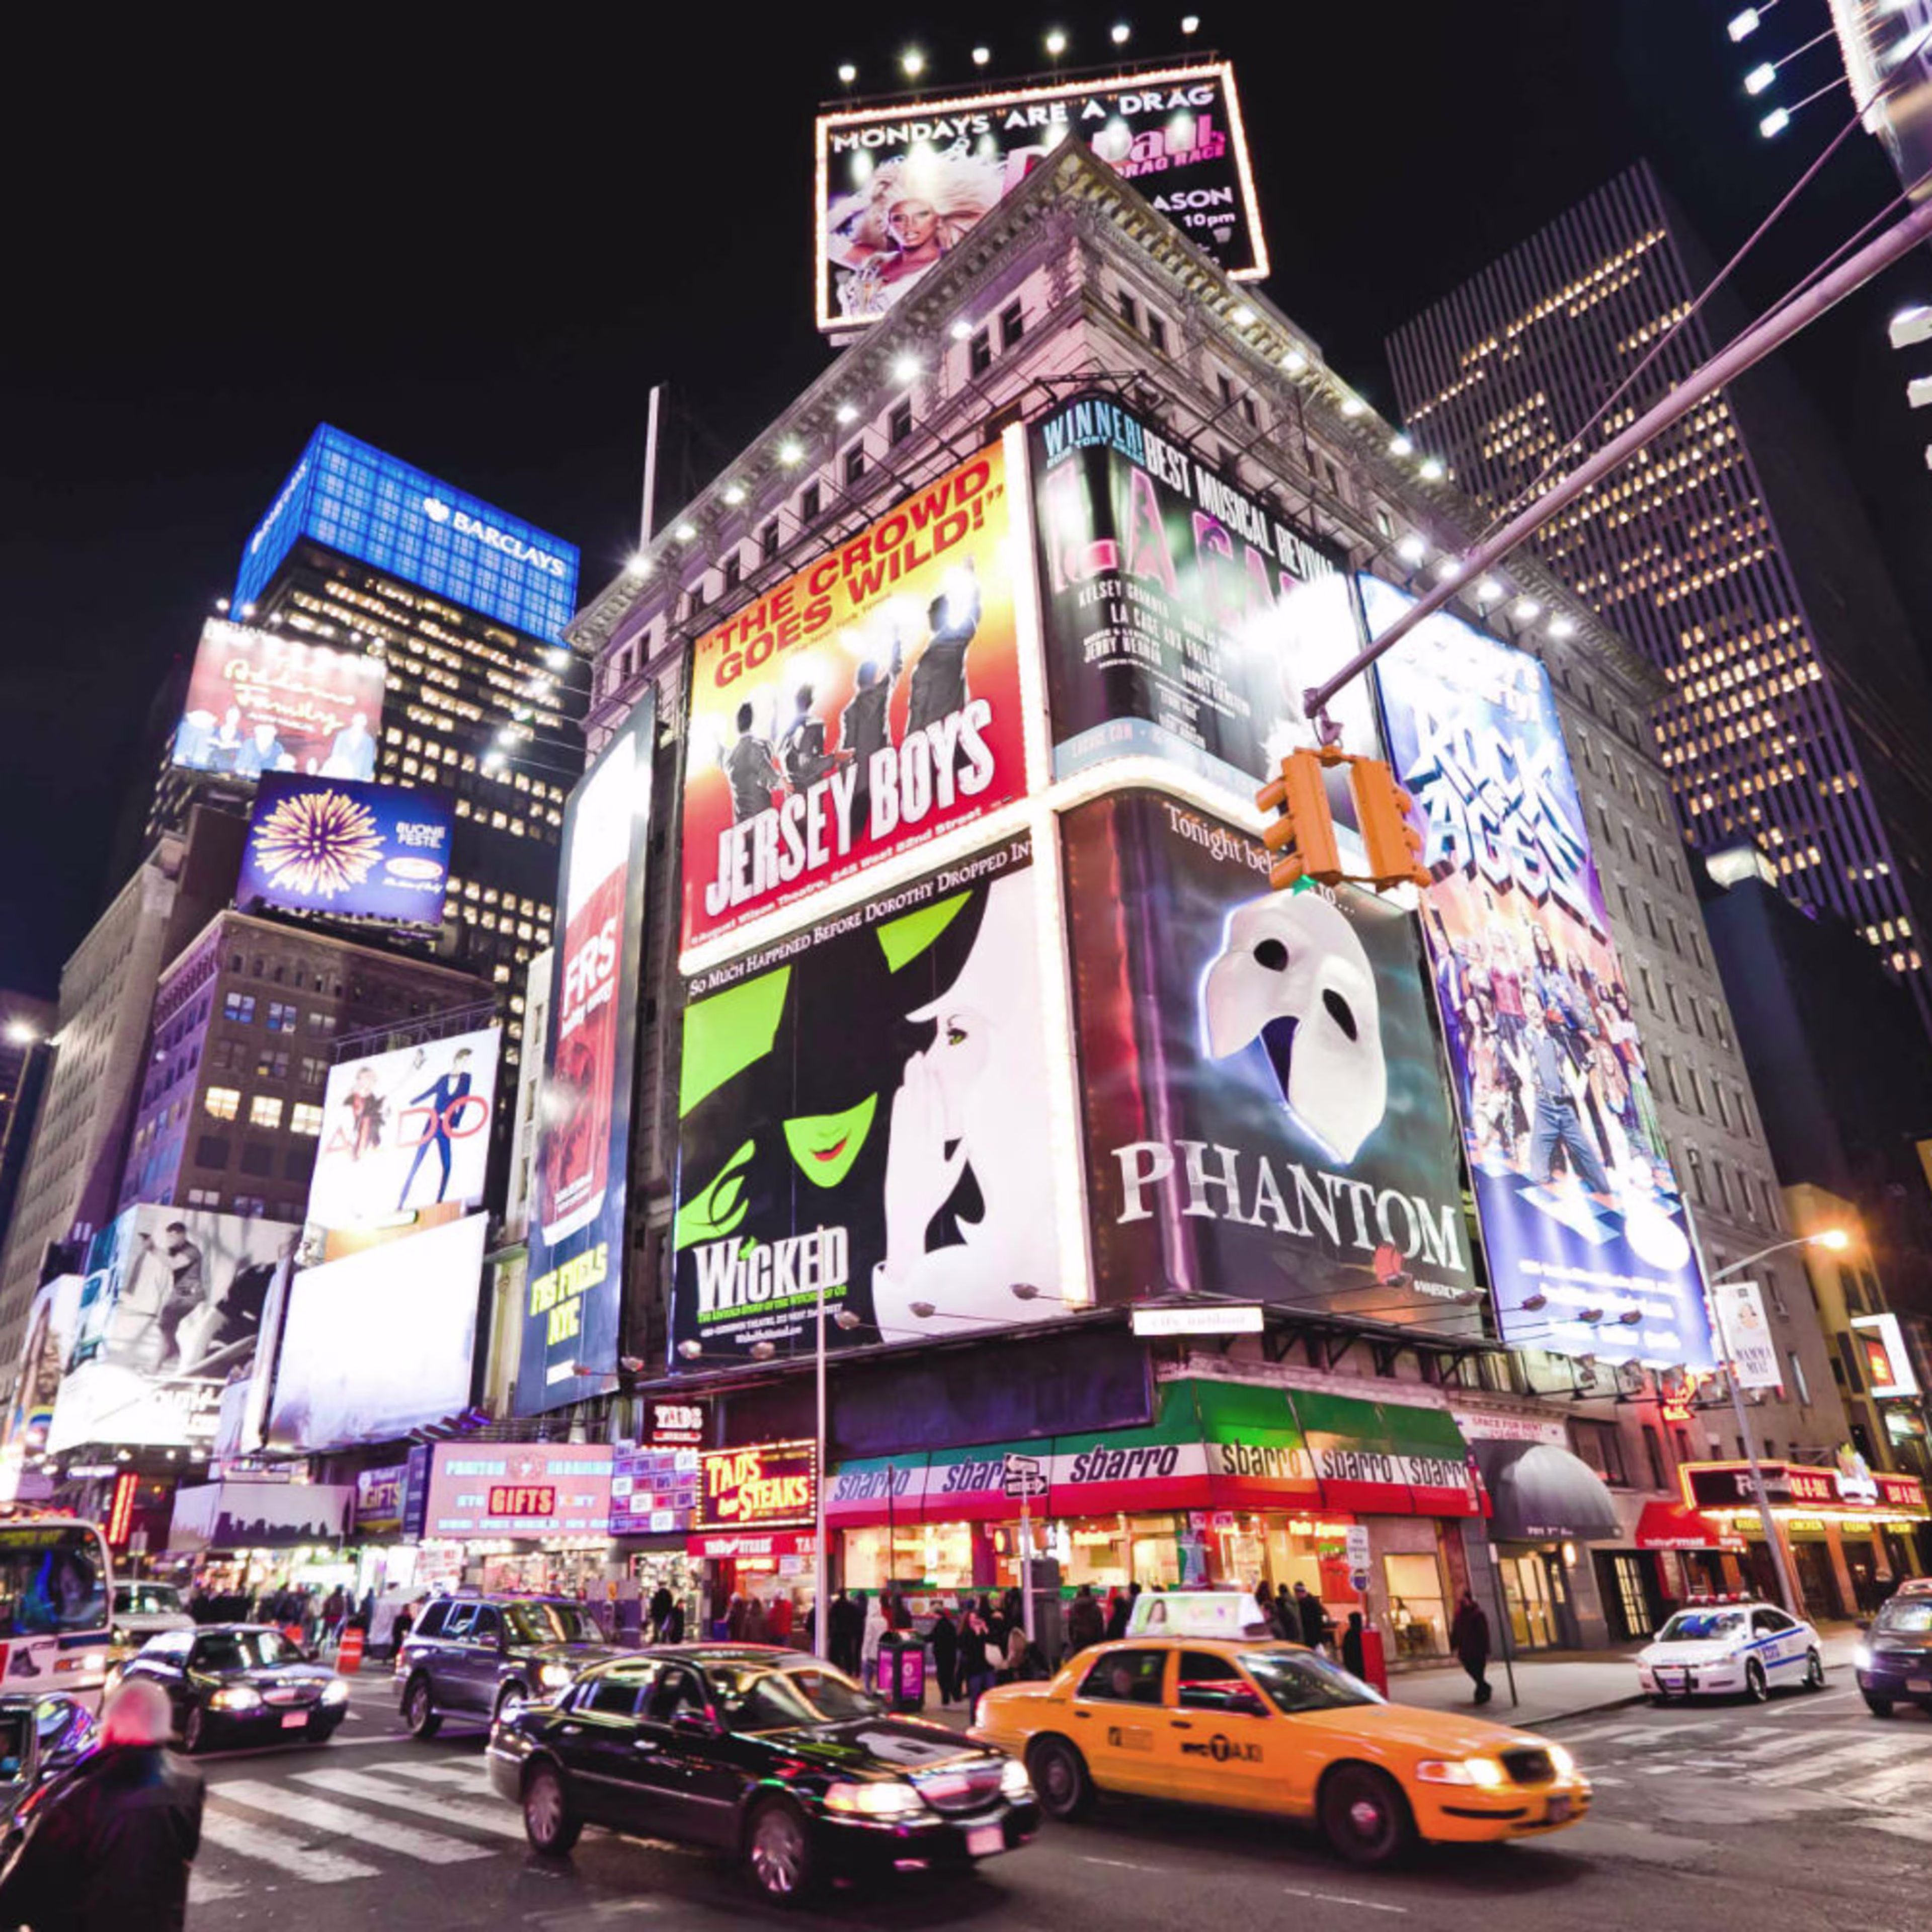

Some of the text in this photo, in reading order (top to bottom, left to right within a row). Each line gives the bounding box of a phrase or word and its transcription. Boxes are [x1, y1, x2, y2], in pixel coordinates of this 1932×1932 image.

[833, 87, 1214, 153] MONDAYS ARE A DRAG
[1183, 213, 1236, 228] 10pm
[1143, 428, 1191, 499] BEST
[1195, 465, 1275, 557] MUSICAL
[453, 510, 566, 577] BARCLAYS
[809, 460, 991, 597] CROWD
[714, 595, 833, 688] GOES
[705, 698, 995, 917] JERSEY BOYS
[1163, 803, 1242, 862] Tonight
[1111, 1139, 1467, 1273] PHANTOM
[692, 1226, 849, 1314] WICKED
[1070, 1444, 1179, 1483] sbarro
[1223, 1438, 1302, 1478] sbarro
[492, 1489, 552, 1513] GIFTS
[739, 1476, 810, 1521] STEAKS
